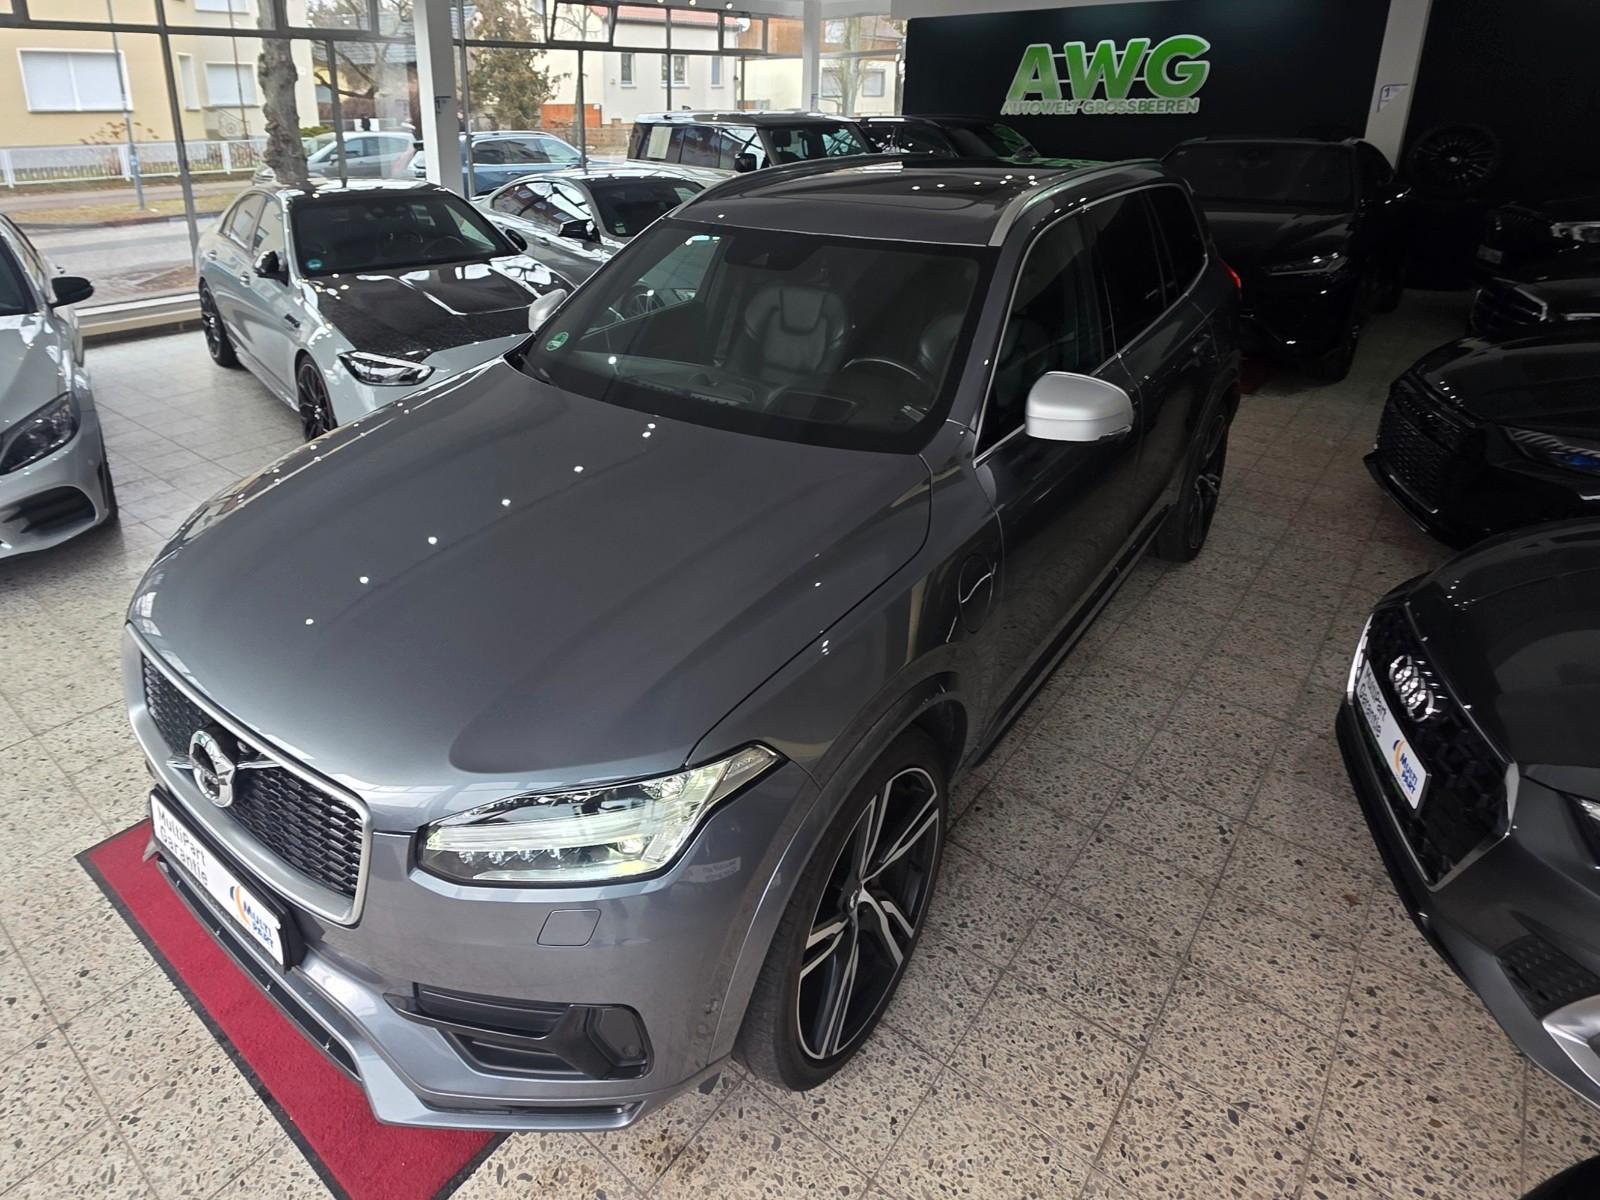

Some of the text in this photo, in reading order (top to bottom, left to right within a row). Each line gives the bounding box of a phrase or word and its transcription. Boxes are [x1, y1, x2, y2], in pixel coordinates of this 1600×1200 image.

[1005, 34, 1211, 100] AWG
[157, 805, 207, 867] MultiPart
[159, 824, 209, 886] Garantie
